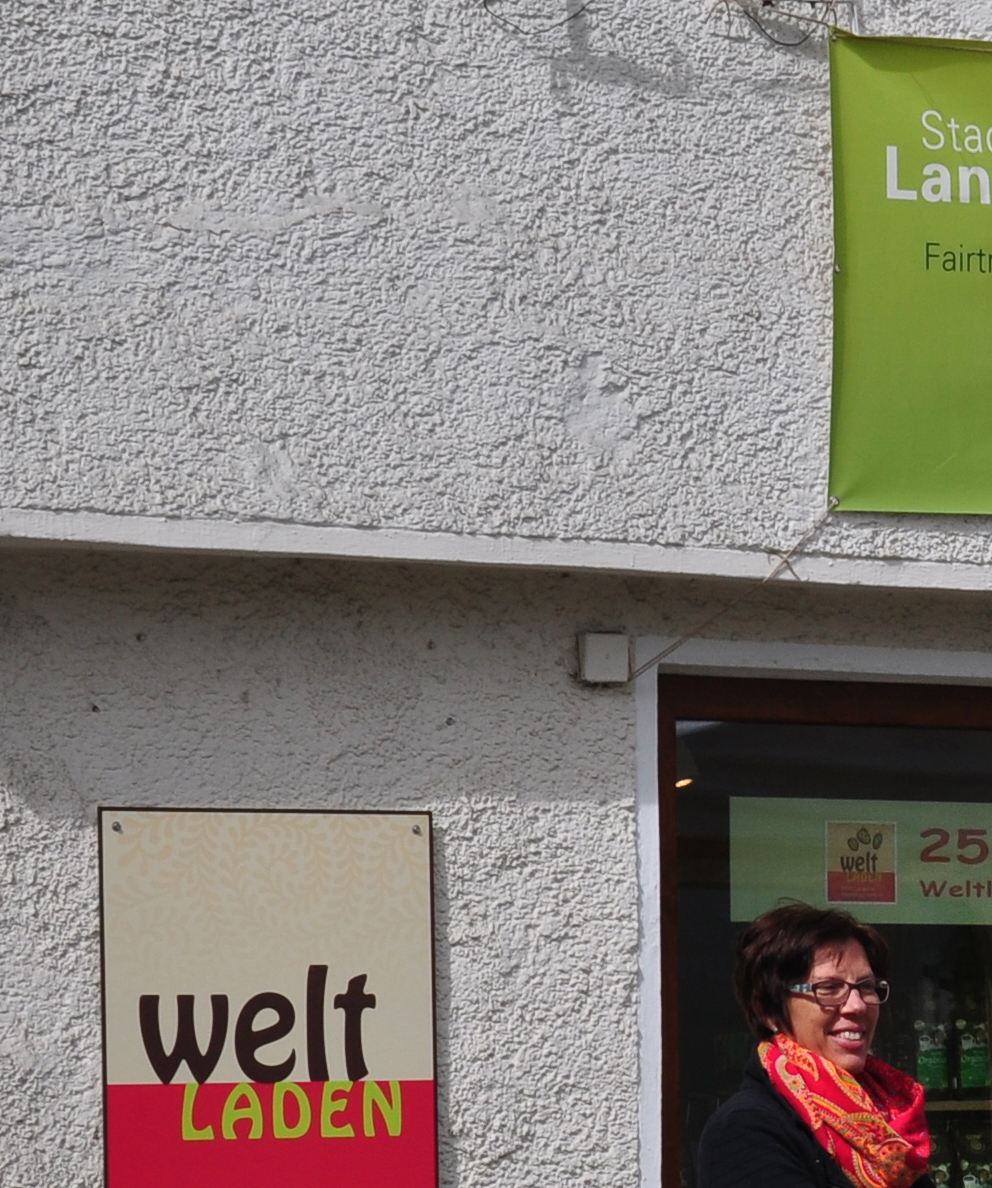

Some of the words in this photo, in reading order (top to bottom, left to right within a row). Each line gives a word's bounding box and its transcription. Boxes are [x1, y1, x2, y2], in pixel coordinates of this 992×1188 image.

[840, 851, 879, 873] welt
[919, 828, 990, 865] 25
[138, 964, 377, 1086] welt
[181, 1079, 402, 1140] LADEN
